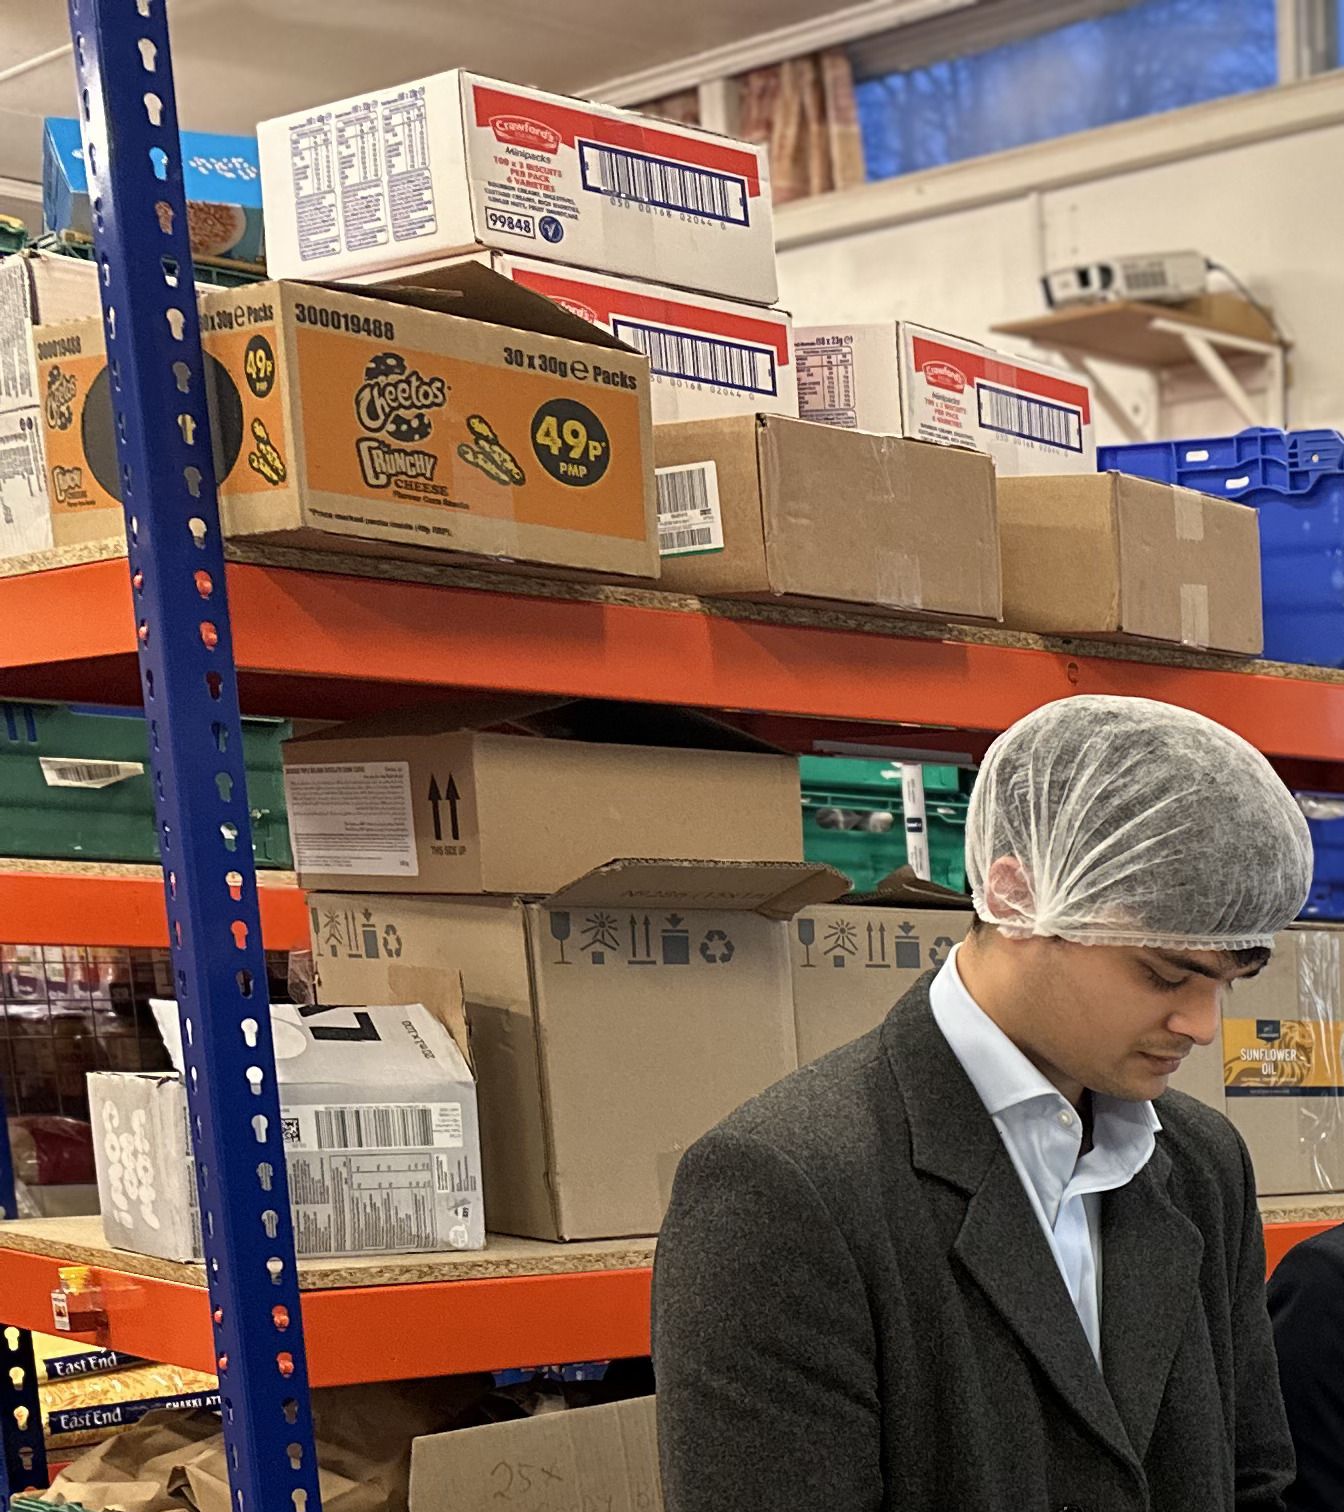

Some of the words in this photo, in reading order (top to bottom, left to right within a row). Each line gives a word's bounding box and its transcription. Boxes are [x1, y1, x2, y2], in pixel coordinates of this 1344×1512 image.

[496, 120, 555, 143] Crawford's
[506, 146, 551, 164] Minipacks
[490, 213, 531, 233] 99848
[246, 303, 273, 323] Packs
[295, 303, 395, 341] 300019488
[504, 346, 523, 367] 30
[537, 353, 568, 378] 30g
[593, 364, 637, 391] Packs
[355, 371, 446, 432] Cheetos
[560, 462, 587, 479] PMP
[394, 479, 449, 496] CHEESE
[430, 845, 443, 856] THIS
[444, 845, 457, 856] SIDE
[458, 845, 466, 856] UP
[1240, 1048, 1297, 1062] SUNFLOWER
[1261, 1062, 1277, 1075] OIL
[54, 1361, 87, 1376] East
[88, 1352, 118, 1372] End
[60, 1414, 91, 1430] East
[93, 1407, 122, 1426] End
